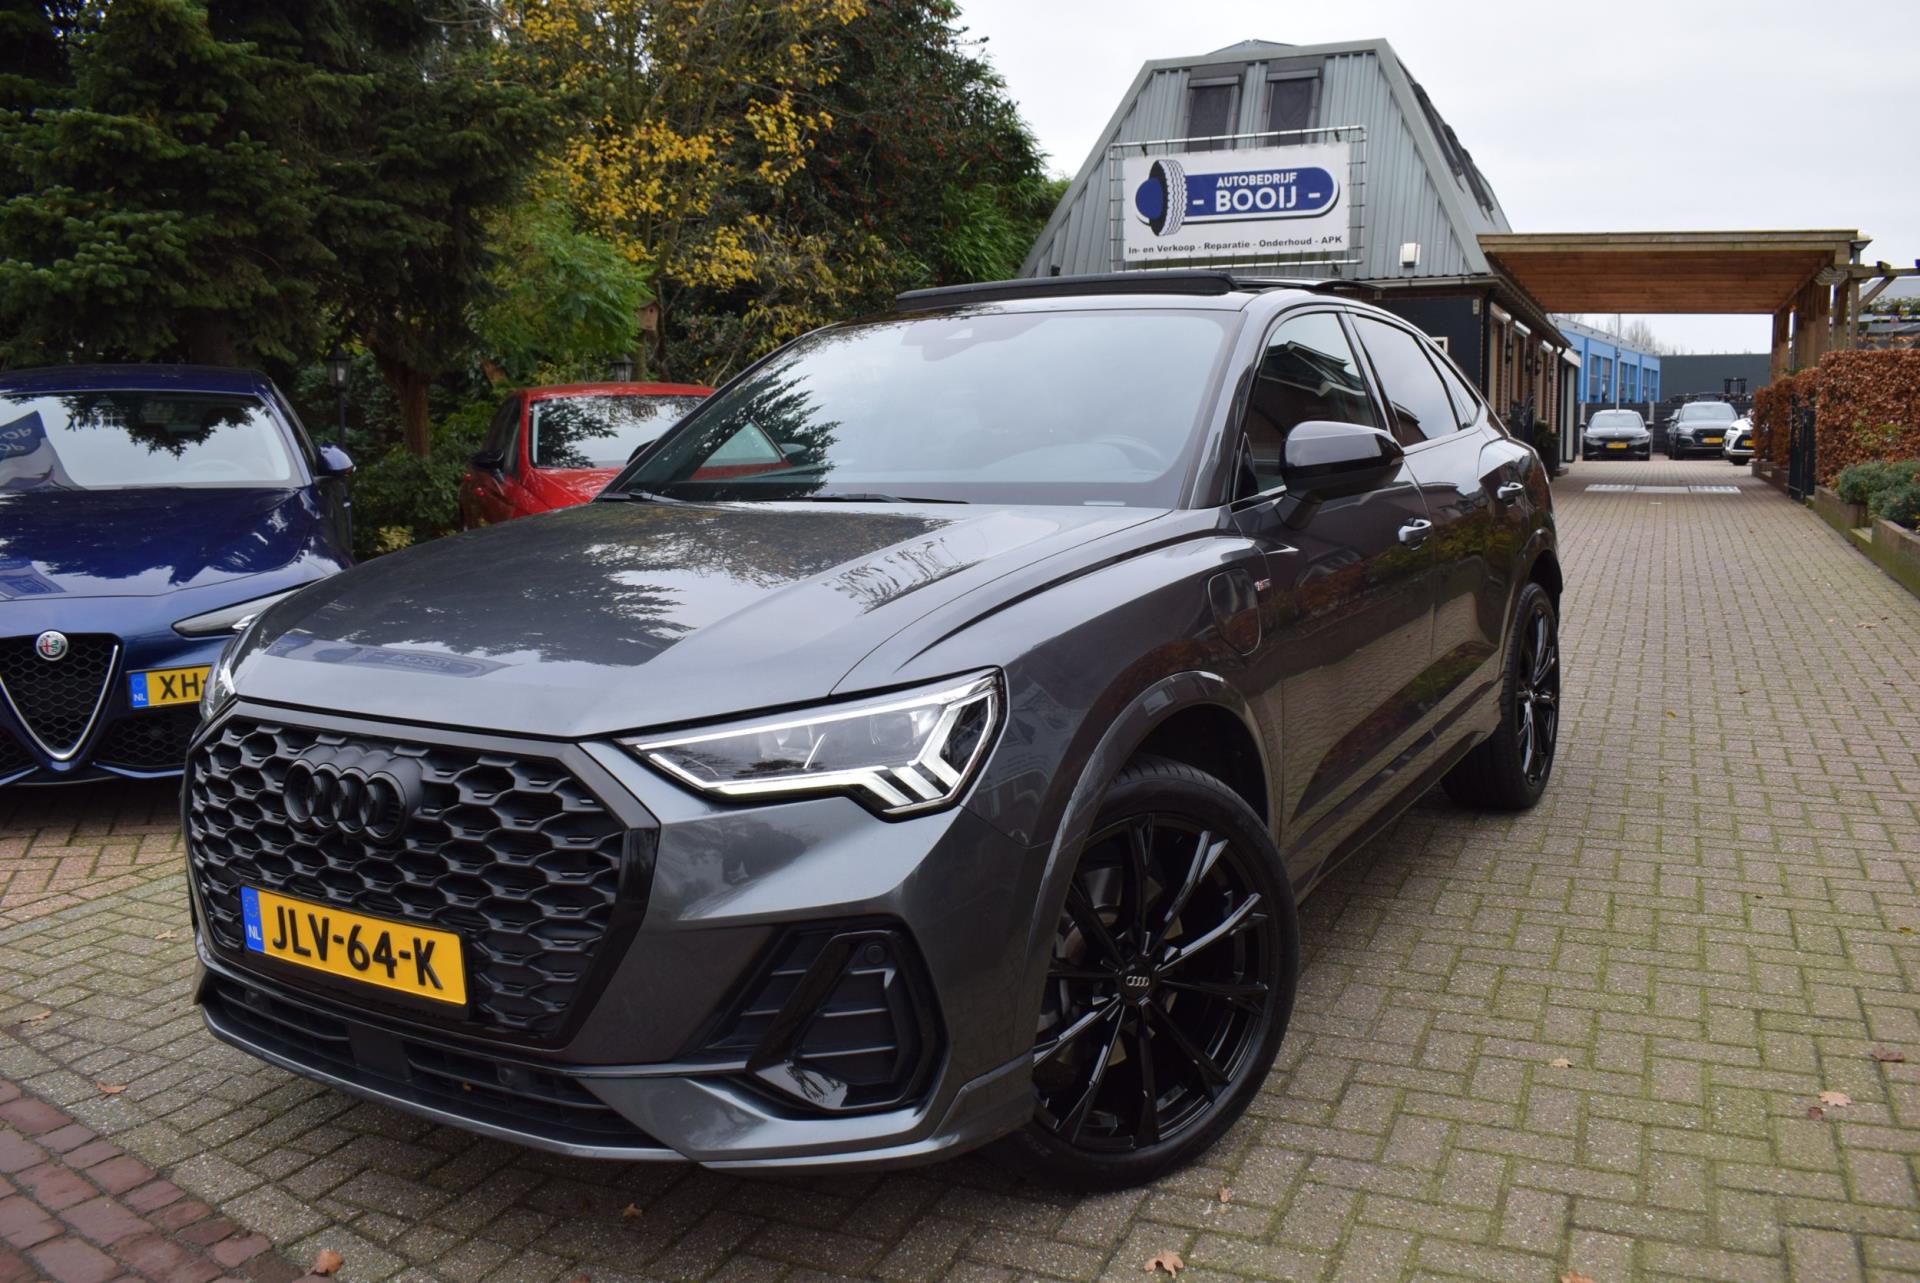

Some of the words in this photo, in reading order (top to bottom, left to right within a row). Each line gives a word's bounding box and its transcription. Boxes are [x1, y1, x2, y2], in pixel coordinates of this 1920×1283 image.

[1216, 172, 1298, 188] AUTOBEDRIJF
[1215, 187, 1297, 212] BOOIJ
[1157, 244, 1196, 253] Verkoop
[1204, 240, 1250, 250] Reparatie
[1259, 237, 1312, 247] Onderhoud
[1321, 235, 1343, 244] APK
[133, 693, 146, 702] NL
[248, 924, 262, 941] NL
[272, 905, 444, 990] JLV-64-K
